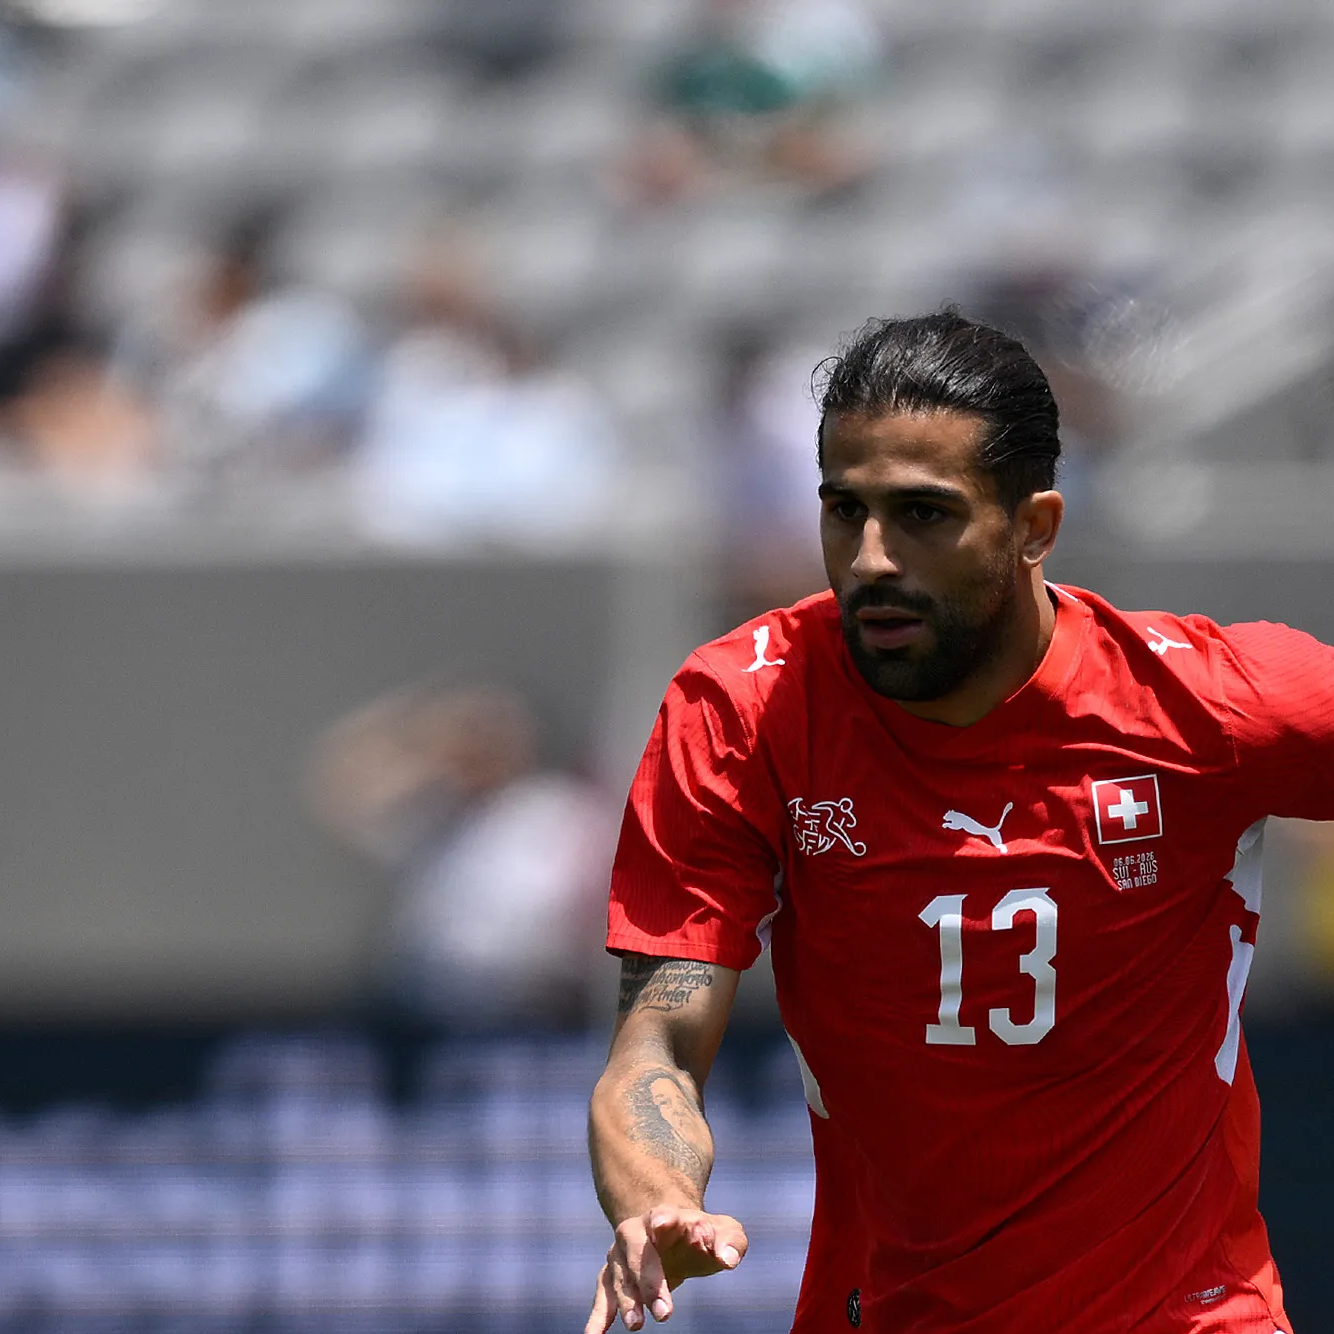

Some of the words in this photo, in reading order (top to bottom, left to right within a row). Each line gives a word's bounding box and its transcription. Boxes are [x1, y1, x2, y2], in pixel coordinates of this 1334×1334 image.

[1113, 851, 1155, 867] 06.06.2026
[1112, 865, 1130, 880] SUI
[1117, 878, 1134, 891] SAN
[1134, 873, 1157, 887] DIEGO
[917, 887, 1058, 1046] 13
